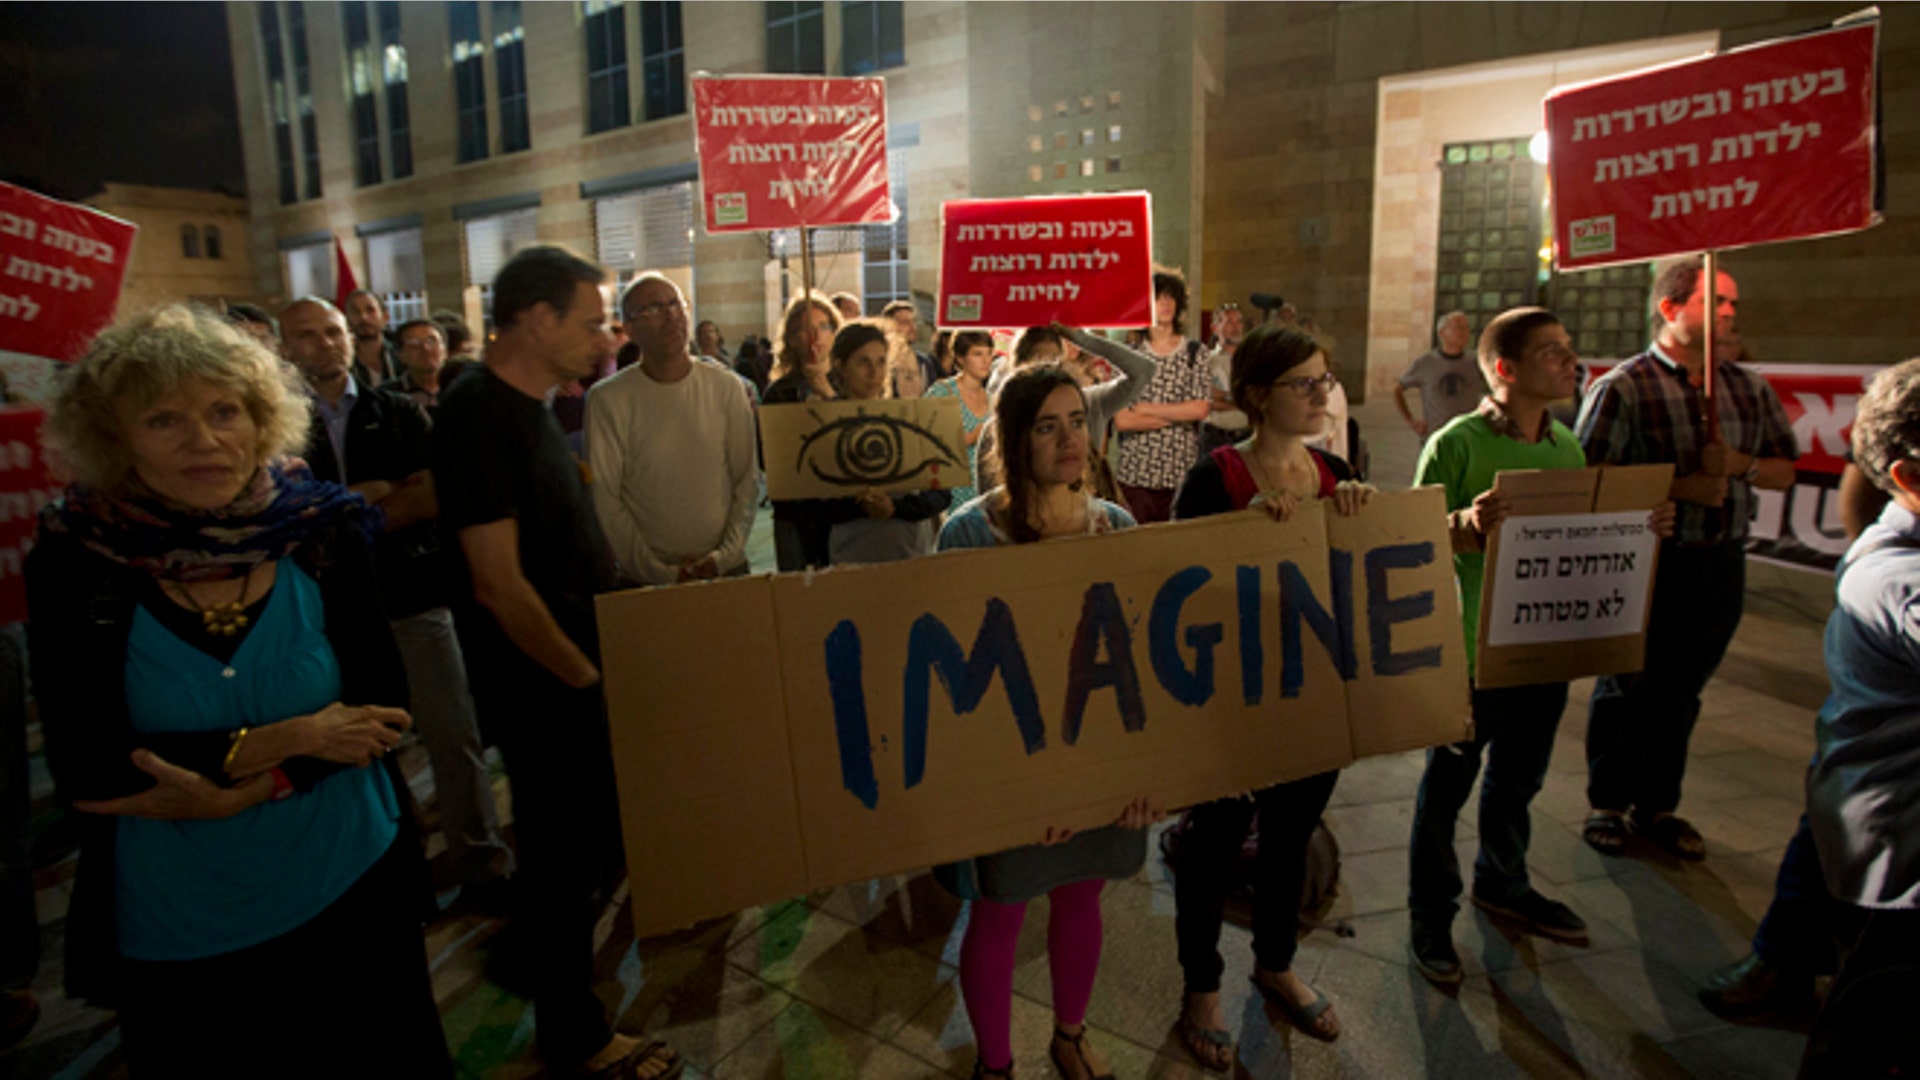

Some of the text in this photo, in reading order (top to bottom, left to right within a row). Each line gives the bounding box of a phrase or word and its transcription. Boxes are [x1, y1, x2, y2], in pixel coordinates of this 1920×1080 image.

[710, 104, 814, 127] ובשדרות
[1572, 68, 1847, 142] בעזה ובשדרות
[729, 142, 796, 164] רוצות
[1593, 121, 1822, 183] ילדות רוצות
[1650, 177, 1760, 220] לחיות
[42, 224, 115, 264] בעזה
[957, 219, 1135, 242] בעזה ובשדרות
[5, 255, 94, 293] ילדות
[969, 248, 1120, 272] ילדות רוצות
[1006, 279, 1081, 302] לחיות
[1515, 551, 1636, 580] אזרחים הם
[1513, 588, 1626, 624] לא מטרות
[824, 541, 1444, 810] IMAGINE
